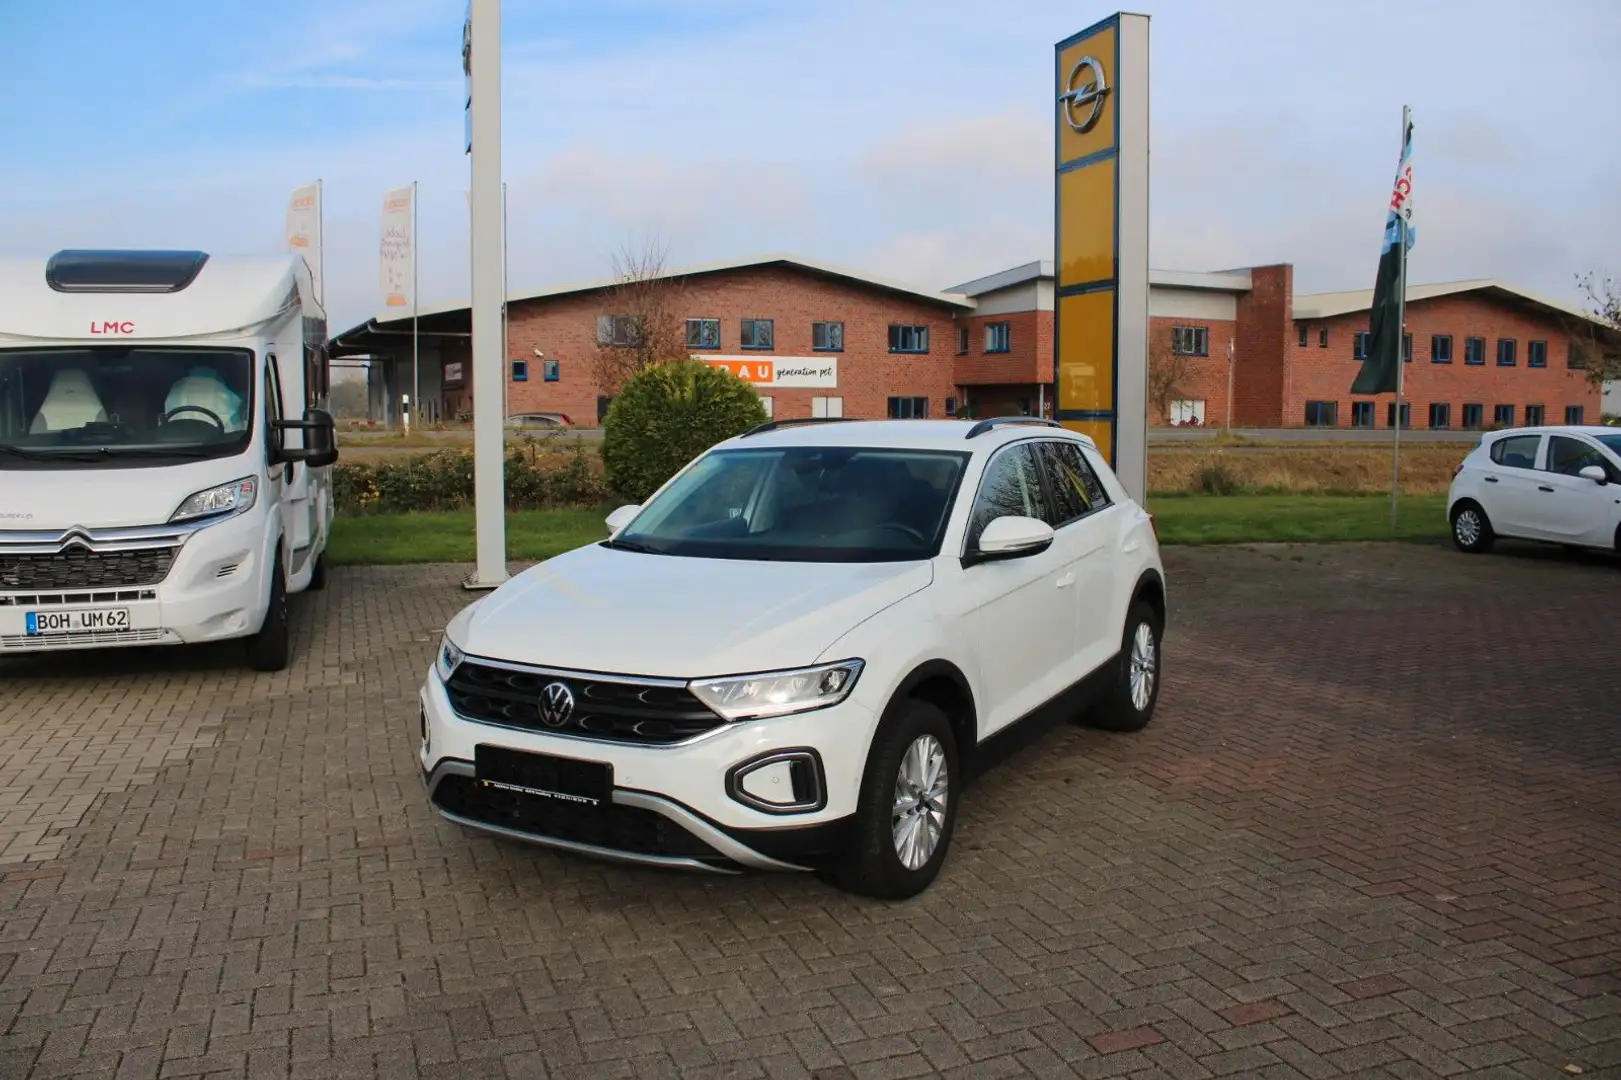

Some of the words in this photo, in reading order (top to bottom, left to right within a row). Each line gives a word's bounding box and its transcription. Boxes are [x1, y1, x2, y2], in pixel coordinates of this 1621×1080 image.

[90, 321, 134, 334] LMC
[776, 367, 817, 380] generation
[819, 366, 832, 378] pet
[37, 614, 70, 630] BOH
[81, 612, 103, 627] UM
[106, 611, 127, 626] 62
